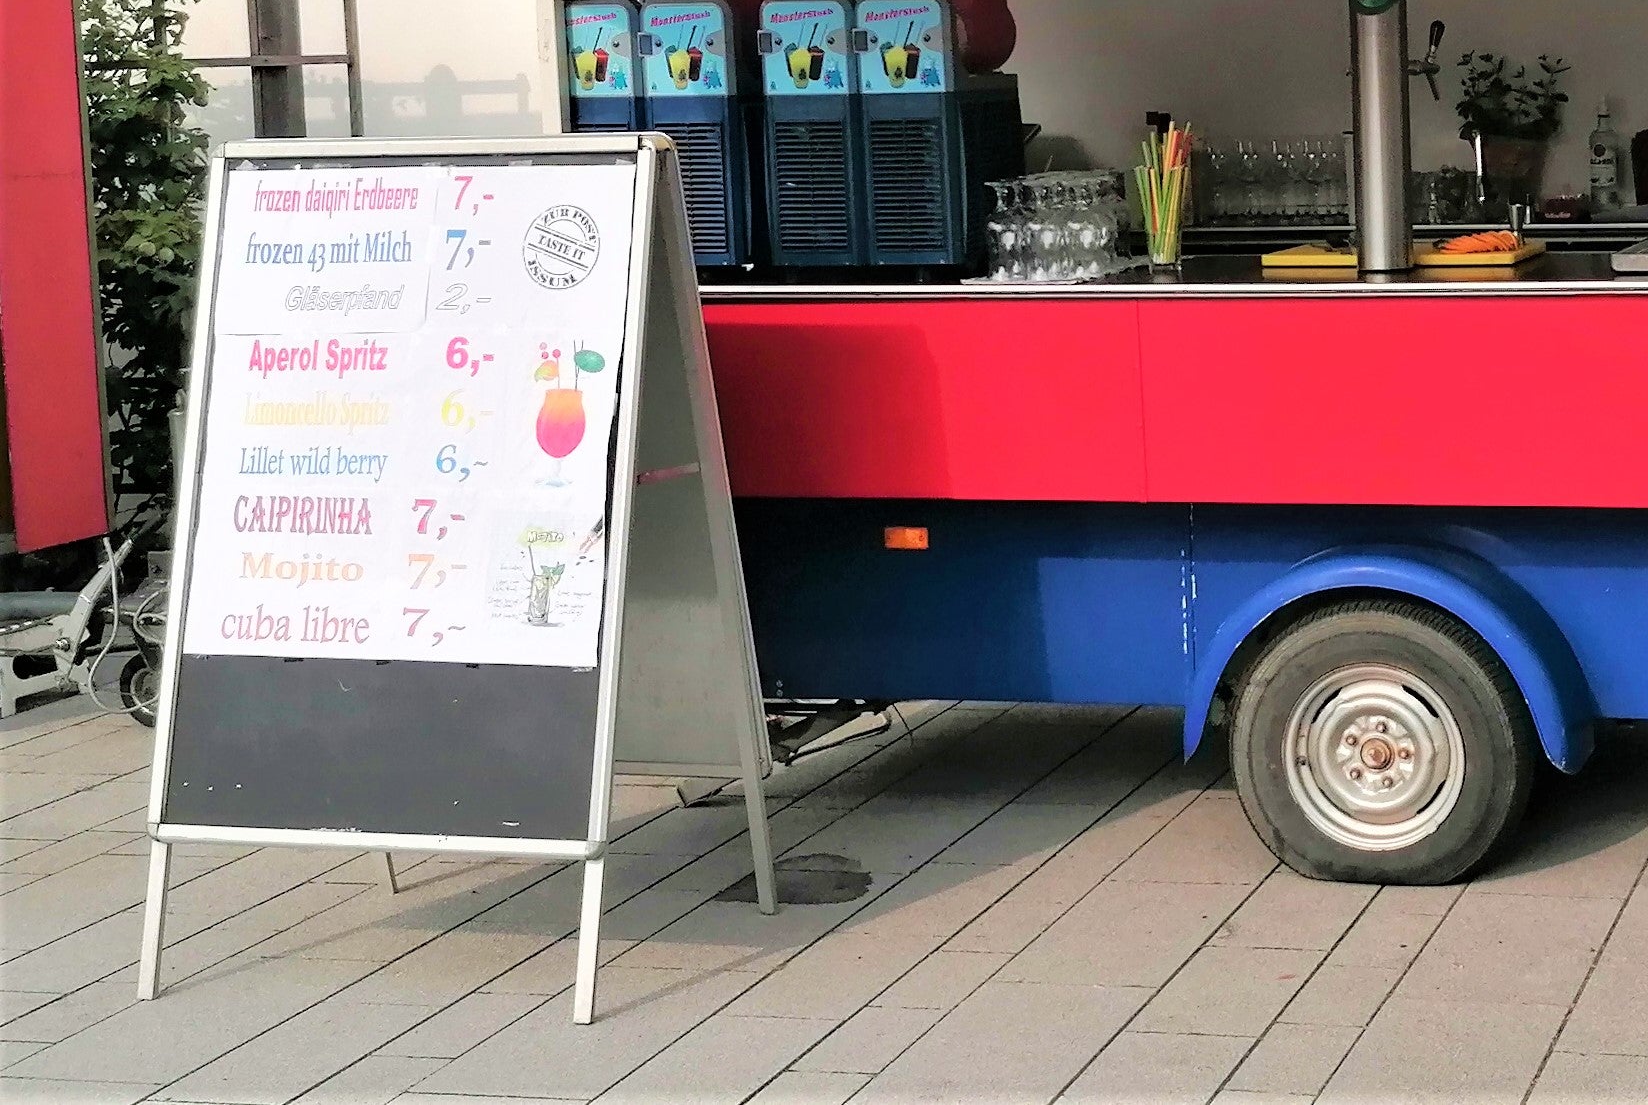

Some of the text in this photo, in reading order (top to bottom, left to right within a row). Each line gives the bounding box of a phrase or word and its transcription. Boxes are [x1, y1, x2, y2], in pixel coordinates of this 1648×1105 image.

[254, 179, 301, 212] frozen
[354, 177, 419, 211] Erdbeere
[245, 231, 303, 264] frozen
[307, 243, 326, 273] 43
[329, 230, 359, 264] mit
[363, 230, 412, 263] Milch
[538, 235, 586, 261] TASTE IT
[284, 283, 405, 317] Gläserpfand
[249, 339, 319, 379] Aperol
[326, 339, 388, 379] Spritz
[239, 447, 285, 475] Lillet
[290, 446, 330, 475] wild
[336, 446, 388, 483] berry
[233, 495, 372, 535] CAIPIRINHA
[239, 551, 364, 588] Mojito
[221, 603, 292, 642] cuba
[301, 605, 370, 643] libre
